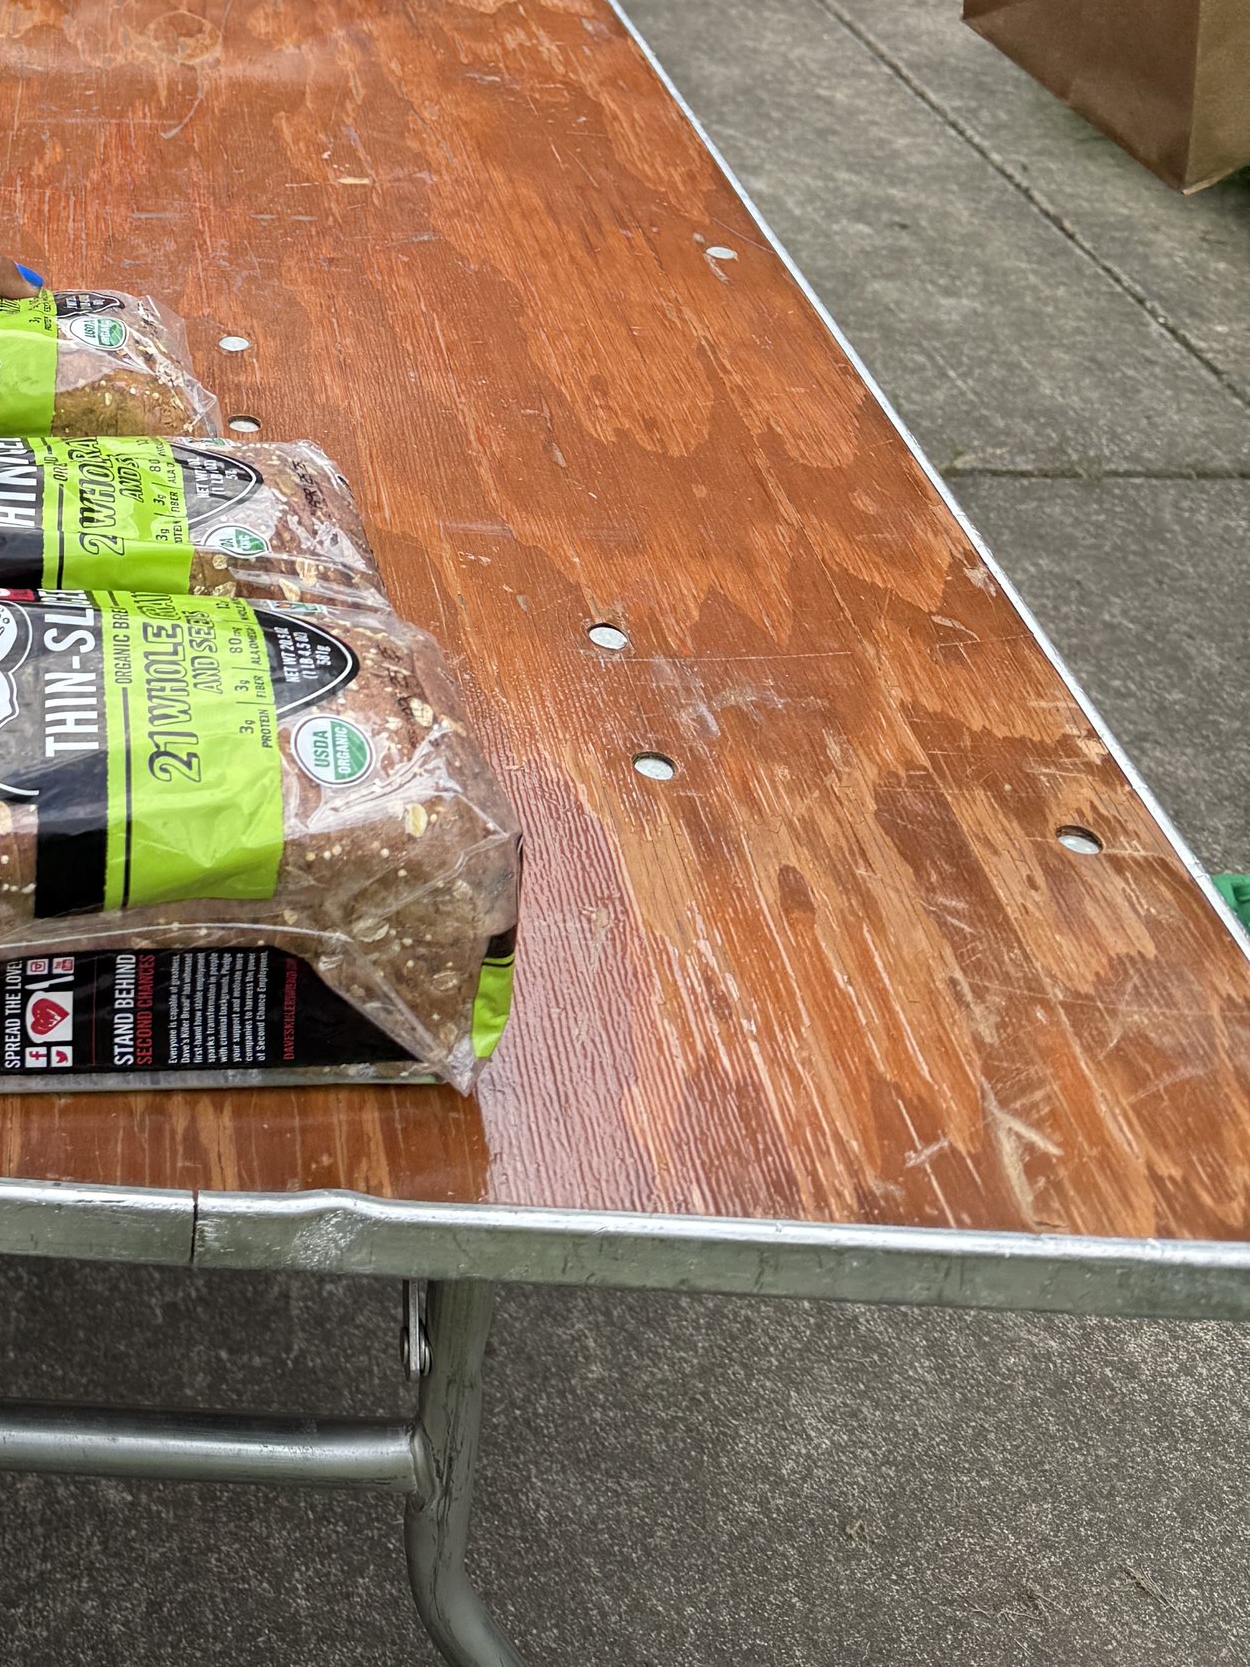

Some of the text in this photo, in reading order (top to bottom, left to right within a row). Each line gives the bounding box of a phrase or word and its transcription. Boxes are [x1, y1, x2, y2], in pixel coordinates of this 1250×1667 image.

[117, 466, 144, 503] AND
[153, 494, 167, 505] 3g
[156, 529, 169, 541] 3g
[278, 635, 293, 651] 20.5
[297, 642, 311, 656] 4.5
[316, 645, 331, 665] 581g
[114, 635, 132, 684] ORGANIC
[250, 650, 261, 665] ALA
[280, 652, 297, 665] WT
[299, 658, 315, 669] LB
[192, 656, 223, 694] AND
[234, 680, 250, 692] 3g
[253, 675, 267, 698] FIBER
[284, 667, 300, 683] NET
[303, 671, 318, 679] (1
[142, 622, 201, 783] 21 WHOLE
[239, 720, 255, 734] 3g
[259, 709, 273, 748] PROTEIN
[312, 730, 331, 768] USDA
[334, 726, 350, 774] ORGANIC
[5, 960, 23, 1068] SPREAD THE LOVE!
[114, 954, 136, 1065] STAND BEHIND
[136, 955, 154, 1065] SECOND CHANCES
[219, 1016, 228, 1045] criminal
[232, 1014, 242, 1042] support
[244, 1020, 254, 1061] companies
[257, 1022, 265, 1050] Second
[168, 1030, 178, 1063] Everyone
[181, 1039, 190, 1063] Dave's
[194, 1026, 203, 1063] first-hand
[207, 1036, 217, 1062] sparks
[219, 1047, 228, 1062] with
[233, 1045, 242, 1062] your
[257, 1053, 266, 1061] of
